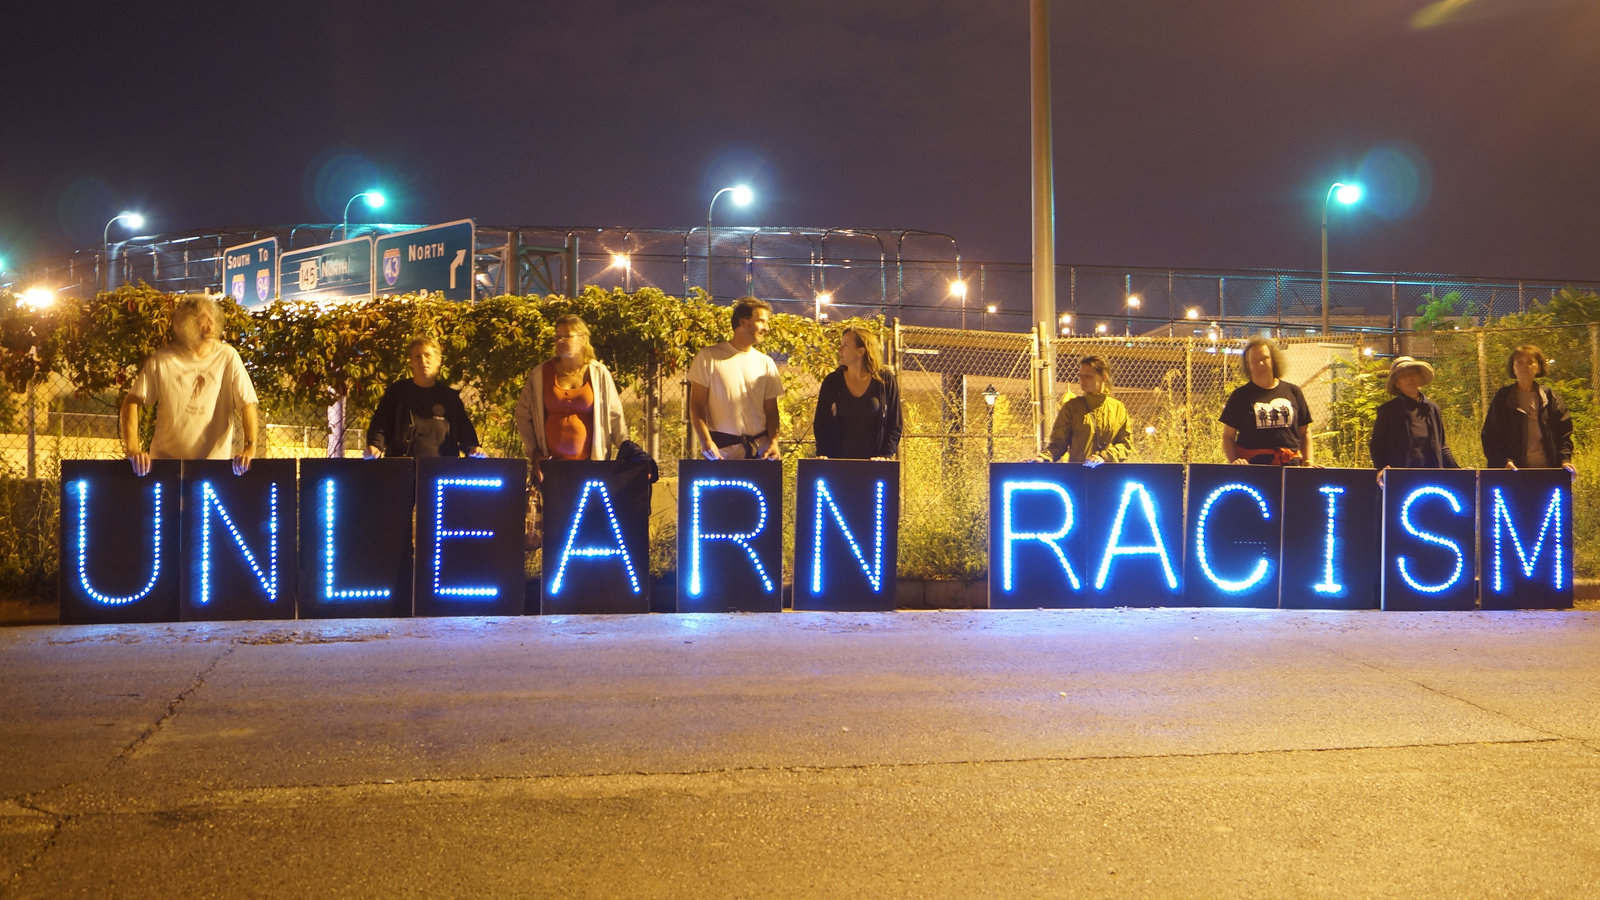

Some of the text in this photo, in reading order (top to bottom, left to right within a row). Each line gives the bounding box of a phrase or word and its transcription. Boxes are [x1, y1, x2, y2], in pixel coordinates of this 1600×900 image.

[408, 242, 445, 261] NORTH
[227, 254, 250, 269] SOUTH
[385, 257, 399, 278] 43
[301, 268, 315, 286] 145
[258, 278, 269, 297] 94
[76, 478, 1563, 605] UNLEARN RACISM
